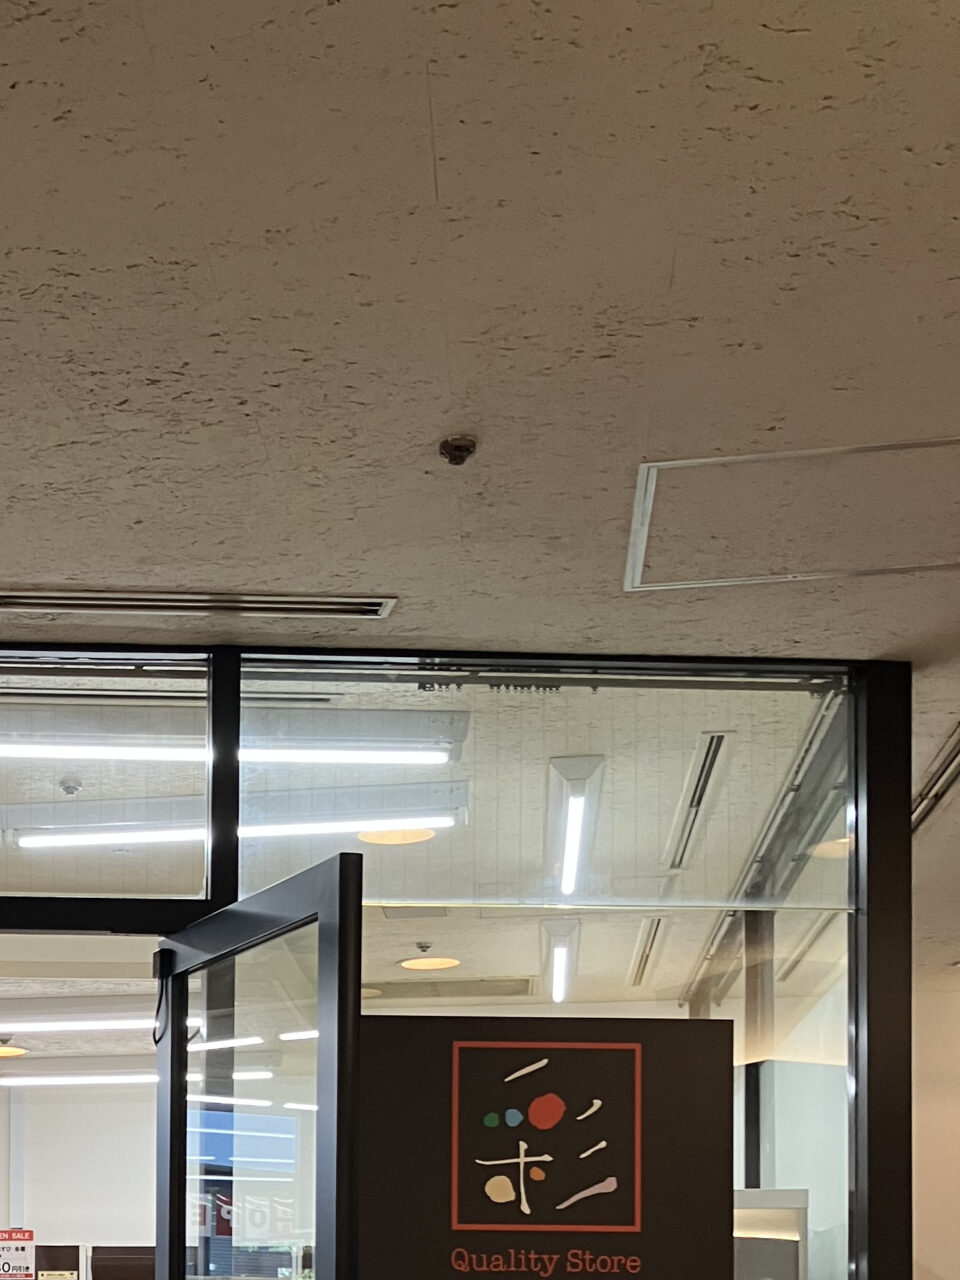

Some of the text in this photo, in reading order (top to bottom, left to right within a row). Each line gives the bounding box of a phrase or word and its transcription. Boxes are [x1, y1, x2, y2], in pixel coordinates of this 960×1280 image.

[11, 1232, 30, 1240] SALE
[450, 1248, 640, 1277] Quality Store
